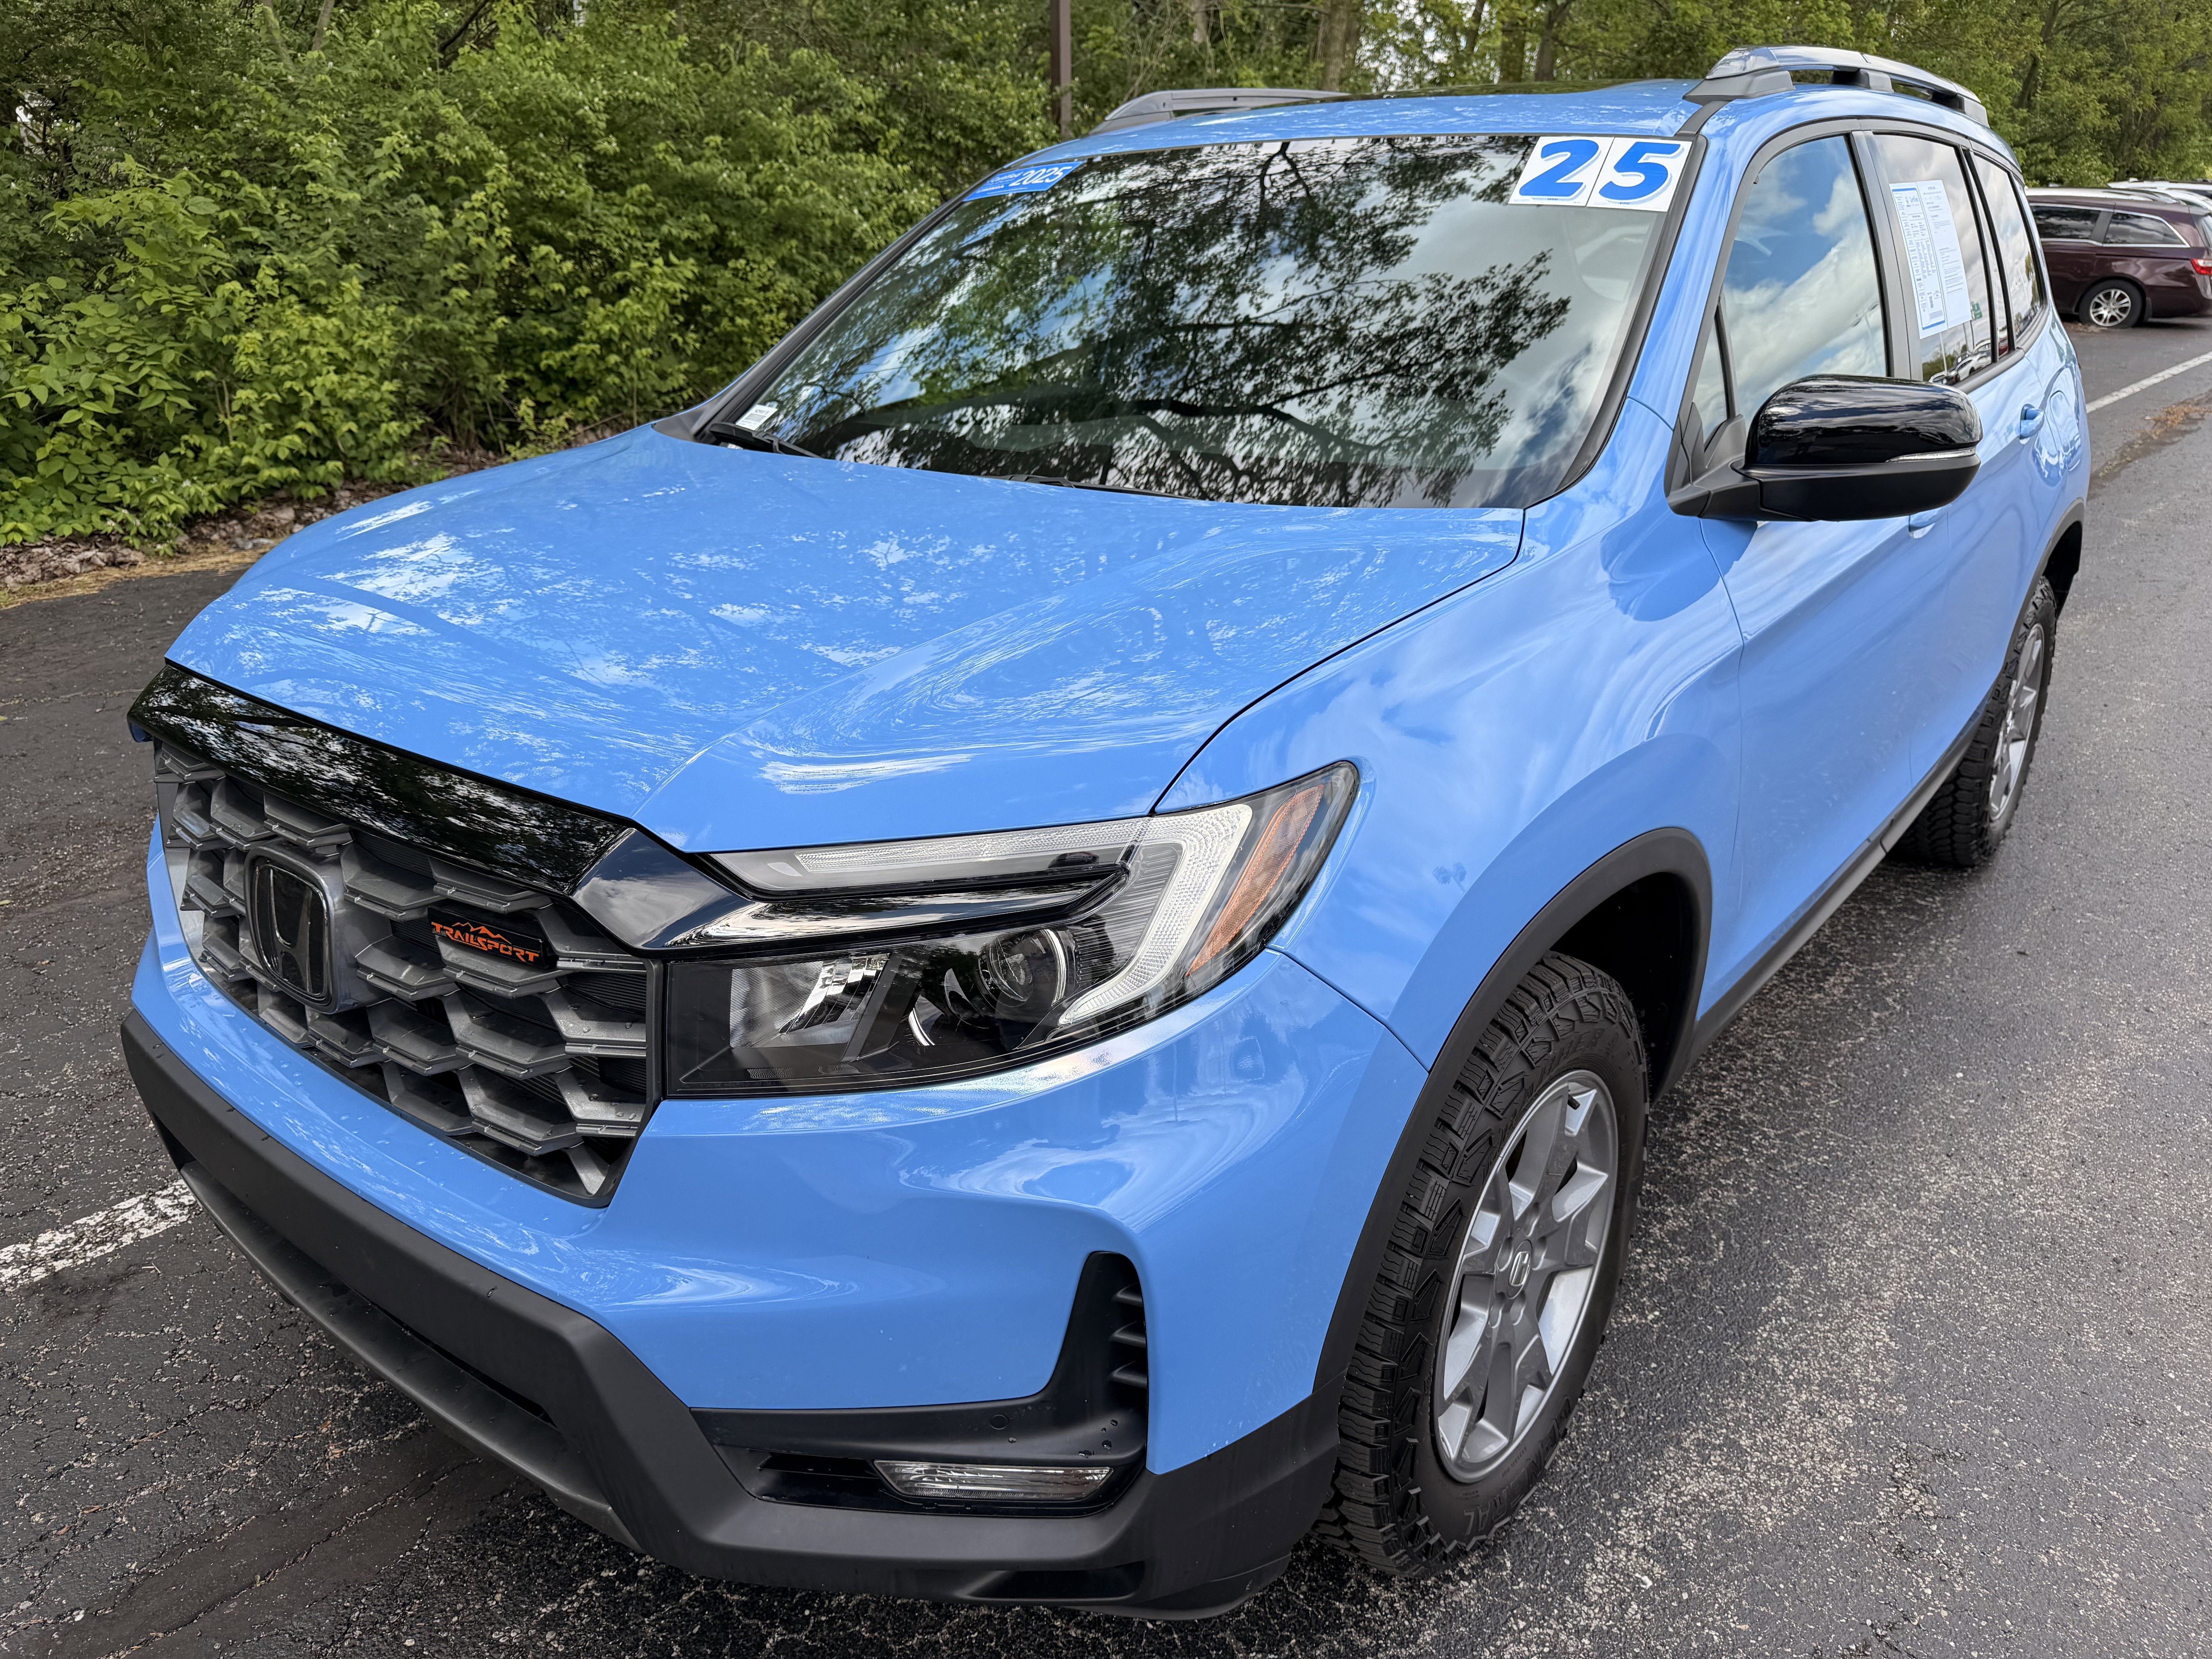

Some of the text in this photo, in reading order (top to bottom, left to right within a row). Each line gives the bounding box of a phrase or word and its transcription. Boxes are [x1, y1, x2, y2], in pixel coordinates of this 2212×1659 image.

[1008, 166, 1072, 187] 2025
[1519, 139, 1682, 201] 25
[431, 921, 539, 963] TRAILSPORT
[1463, 1396, 1571, 1537] GENERAL
